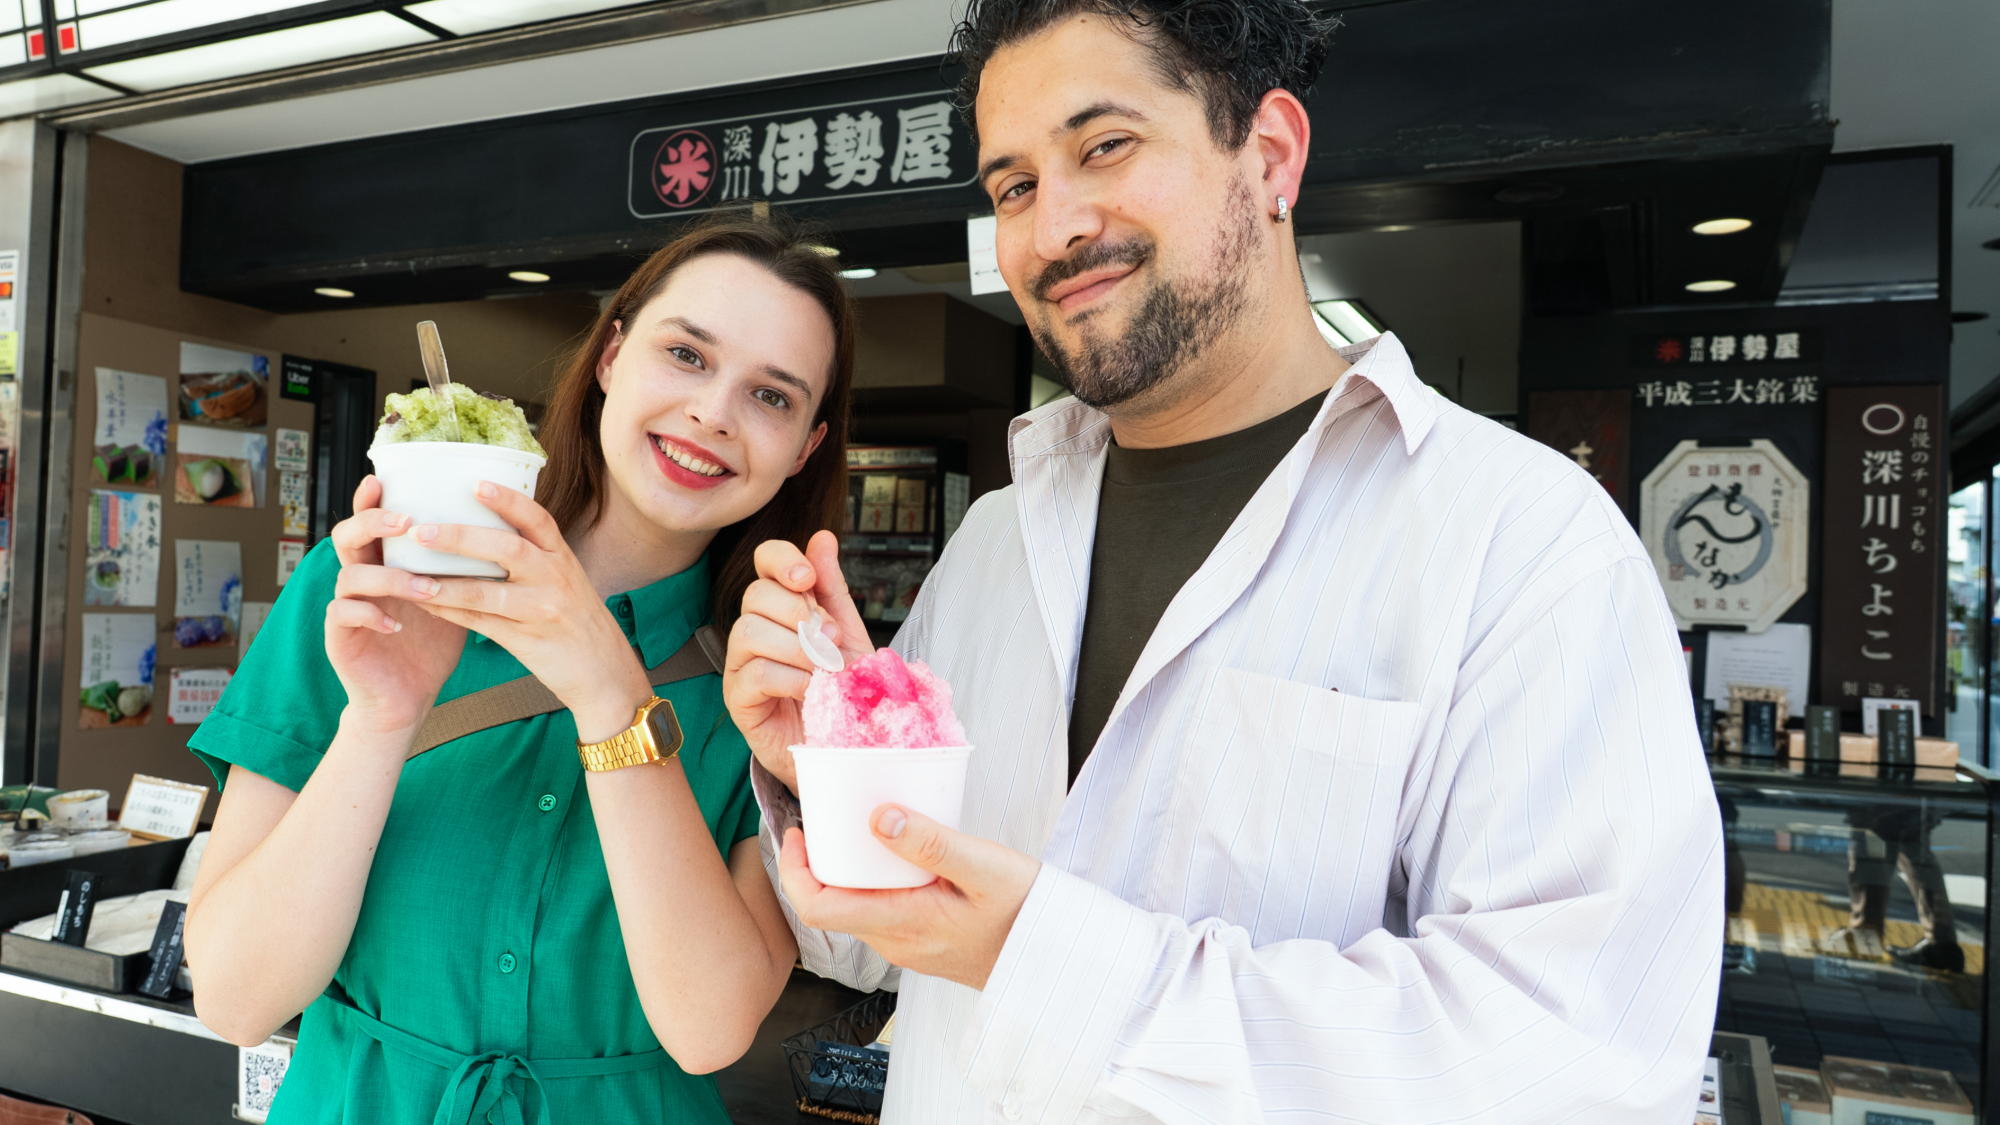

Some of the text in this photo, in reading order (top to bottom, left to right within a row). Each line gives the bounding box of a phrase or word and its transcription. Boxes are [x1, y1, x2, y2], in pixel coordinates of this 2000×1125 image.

[721, 124, 752, 199] 深川
[758, 101, 953, 197] 伊勢屋
[1709, 333, 1800, 362] 伊勢屋
[1636, 376, 1819, 407] 平成三大銘菓
[1842, 681, 1910, 698] 製造元
